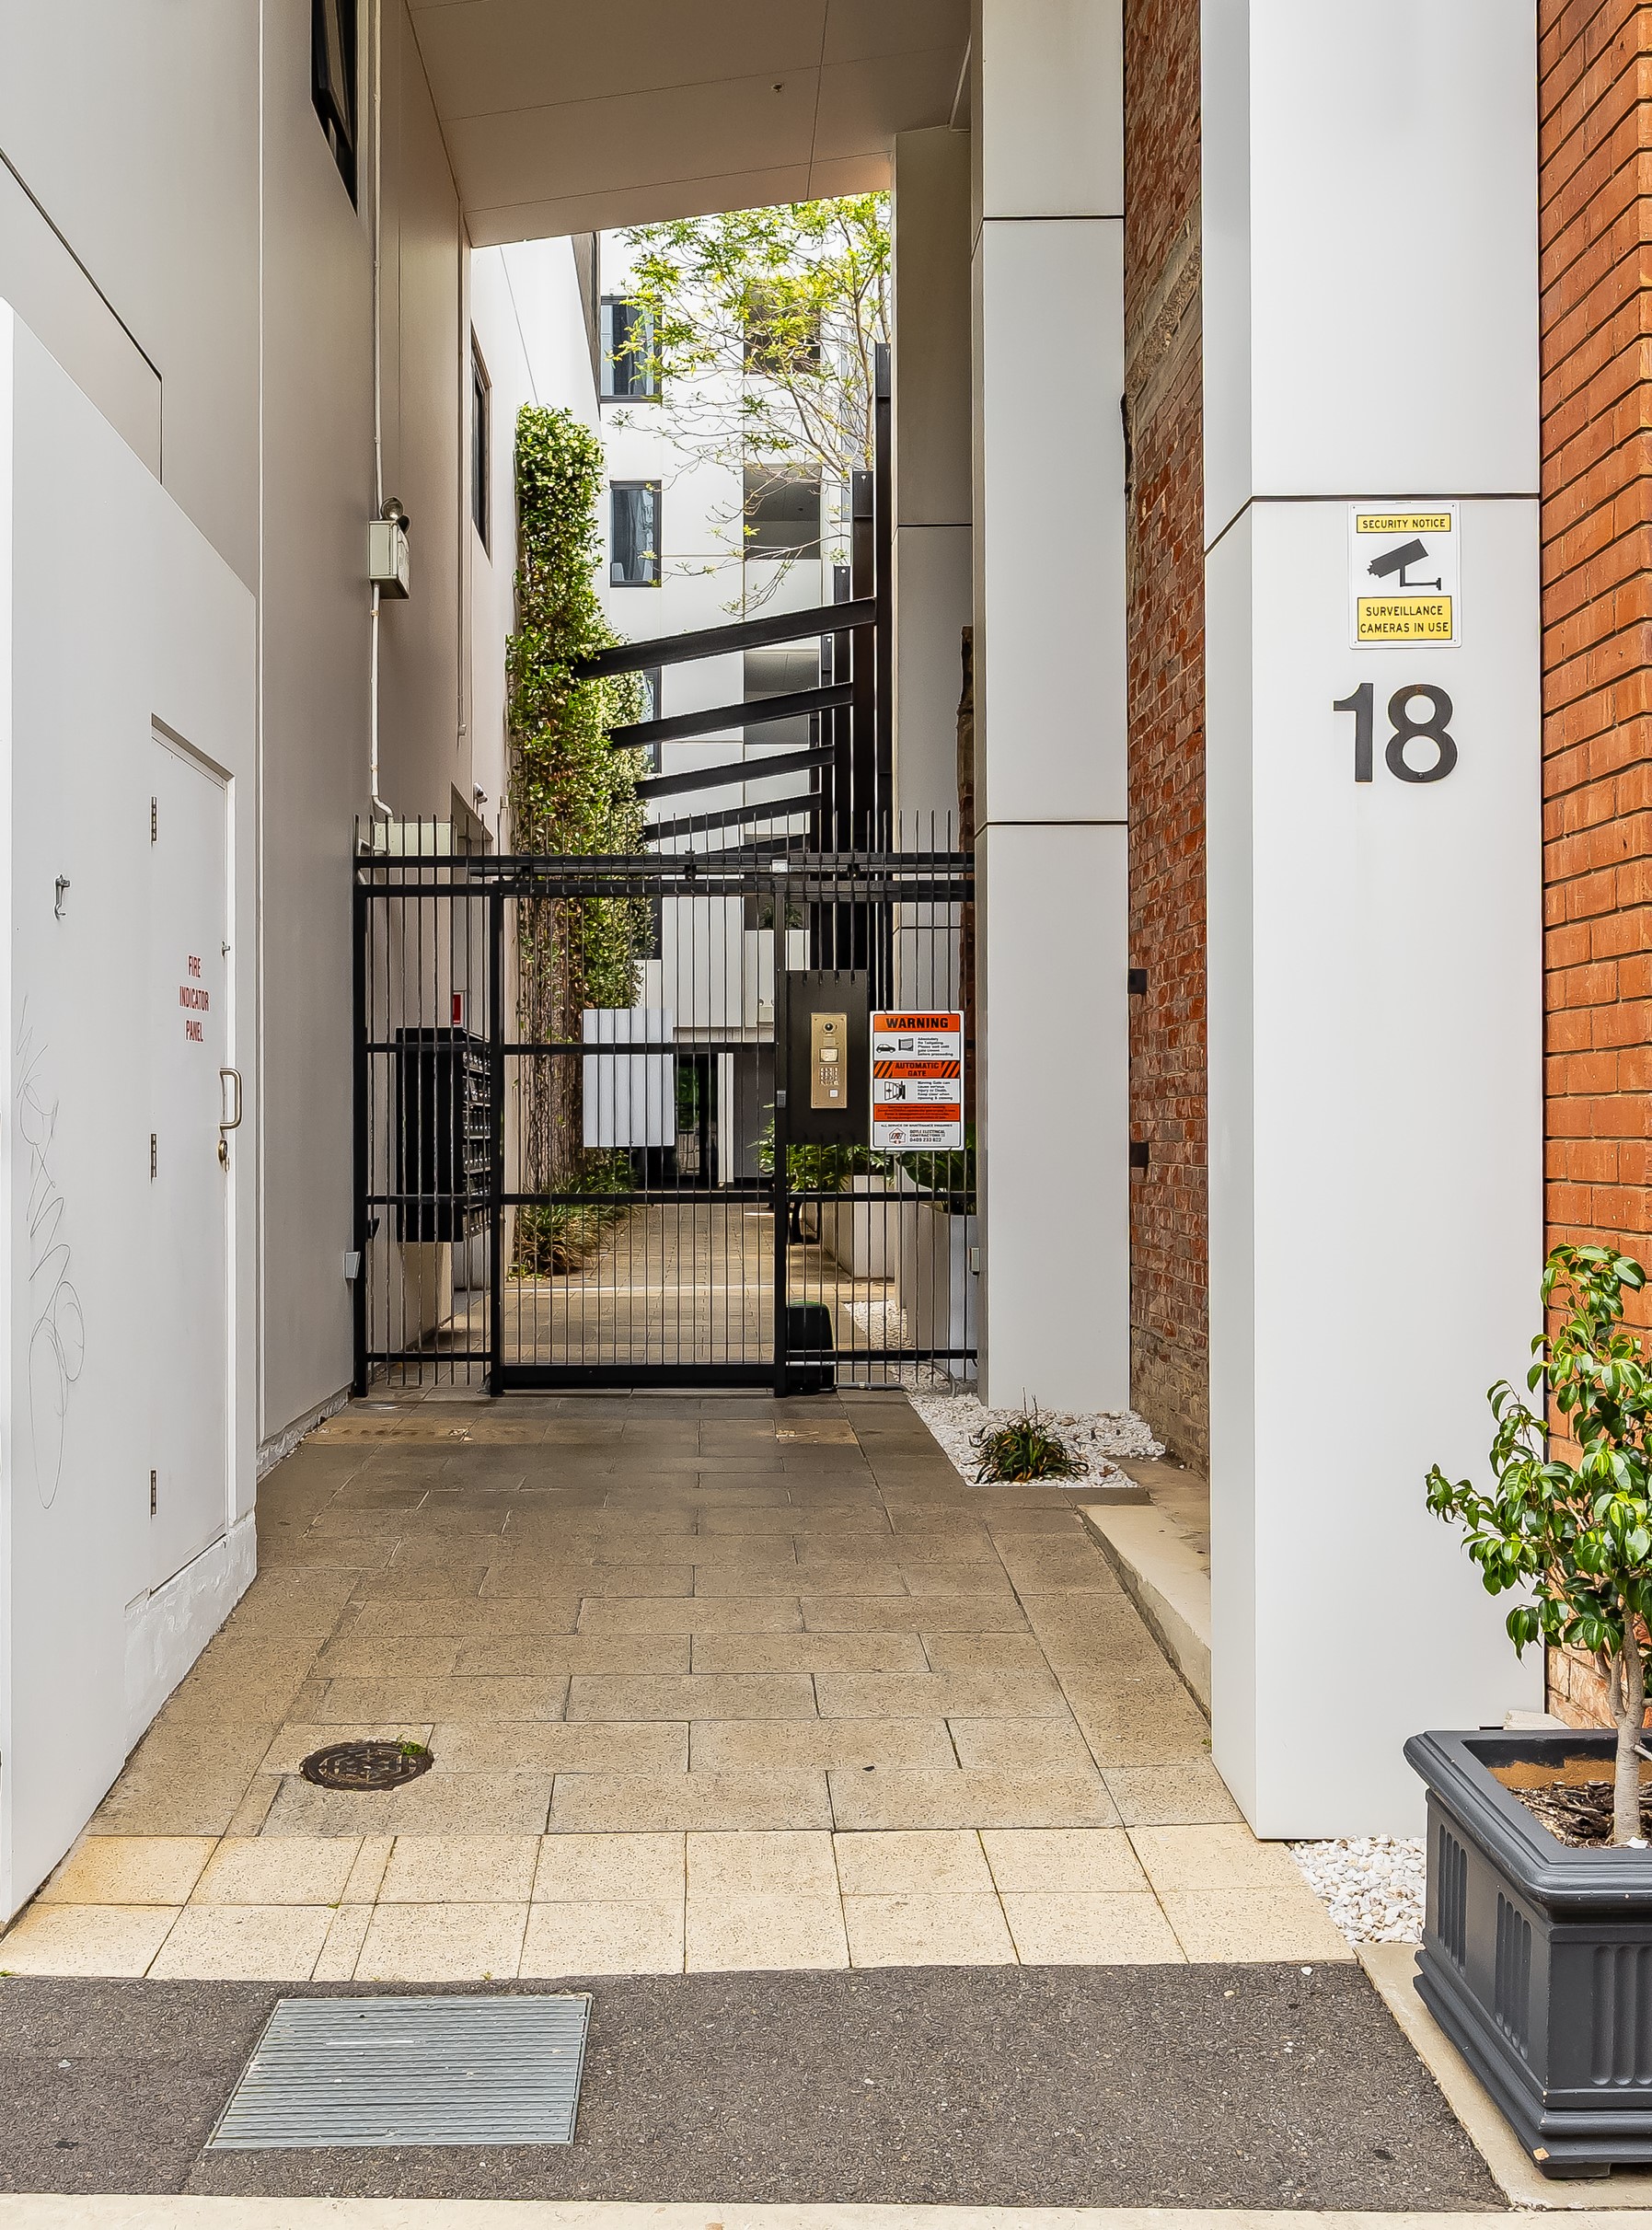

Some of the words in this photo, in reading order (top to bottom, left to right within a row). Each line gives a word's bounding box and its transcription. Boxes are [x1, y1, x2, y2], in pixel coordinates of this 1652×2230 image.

[1362, 519, 1409, 529] SECURITY
[1412, 518, 1446, 528] NOTICE
[1366, 606, 1443, 617] SURVEILLANCE
[1360, 623, 1410, 633] CAMERAS
[1414, 622, 1425, 633] IN
[1428, 622, 1449, 632] USE
[1334, 683, 1458, 783] 18
[188, 955, 201, 978] FIRE
[179, 986, 210, 1011] INDICATOR
[186, 1020, 203, 1042] PANEL
[885, 1017, 949, 1029] WARNING
